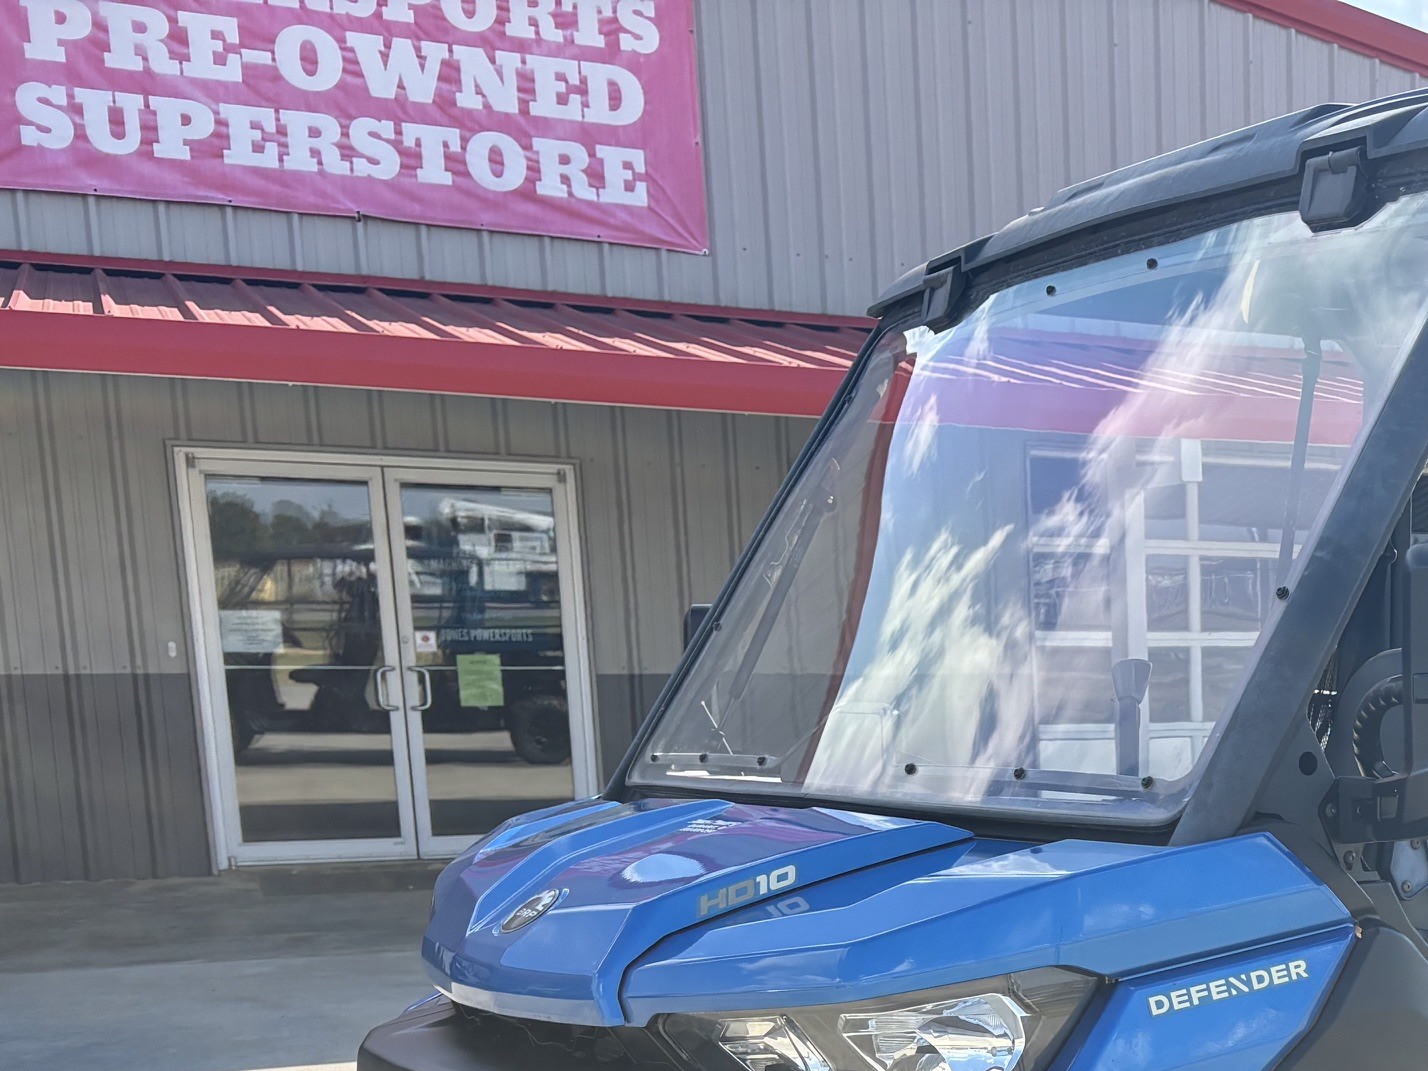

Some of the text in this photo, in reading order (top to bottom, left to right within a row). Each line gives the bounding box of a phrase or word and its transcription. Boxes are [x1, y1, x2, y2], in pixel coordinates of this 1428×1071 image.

[19, 0, 645, 126] PRE-OWNED
[15, 81, 648, 207] SUPERSTORE
[470, 629, 533, 642] POWERSPORTS
[700, 865, 797, 917] HD10
[1148, 960, 1309, 1016] DEFENDER
